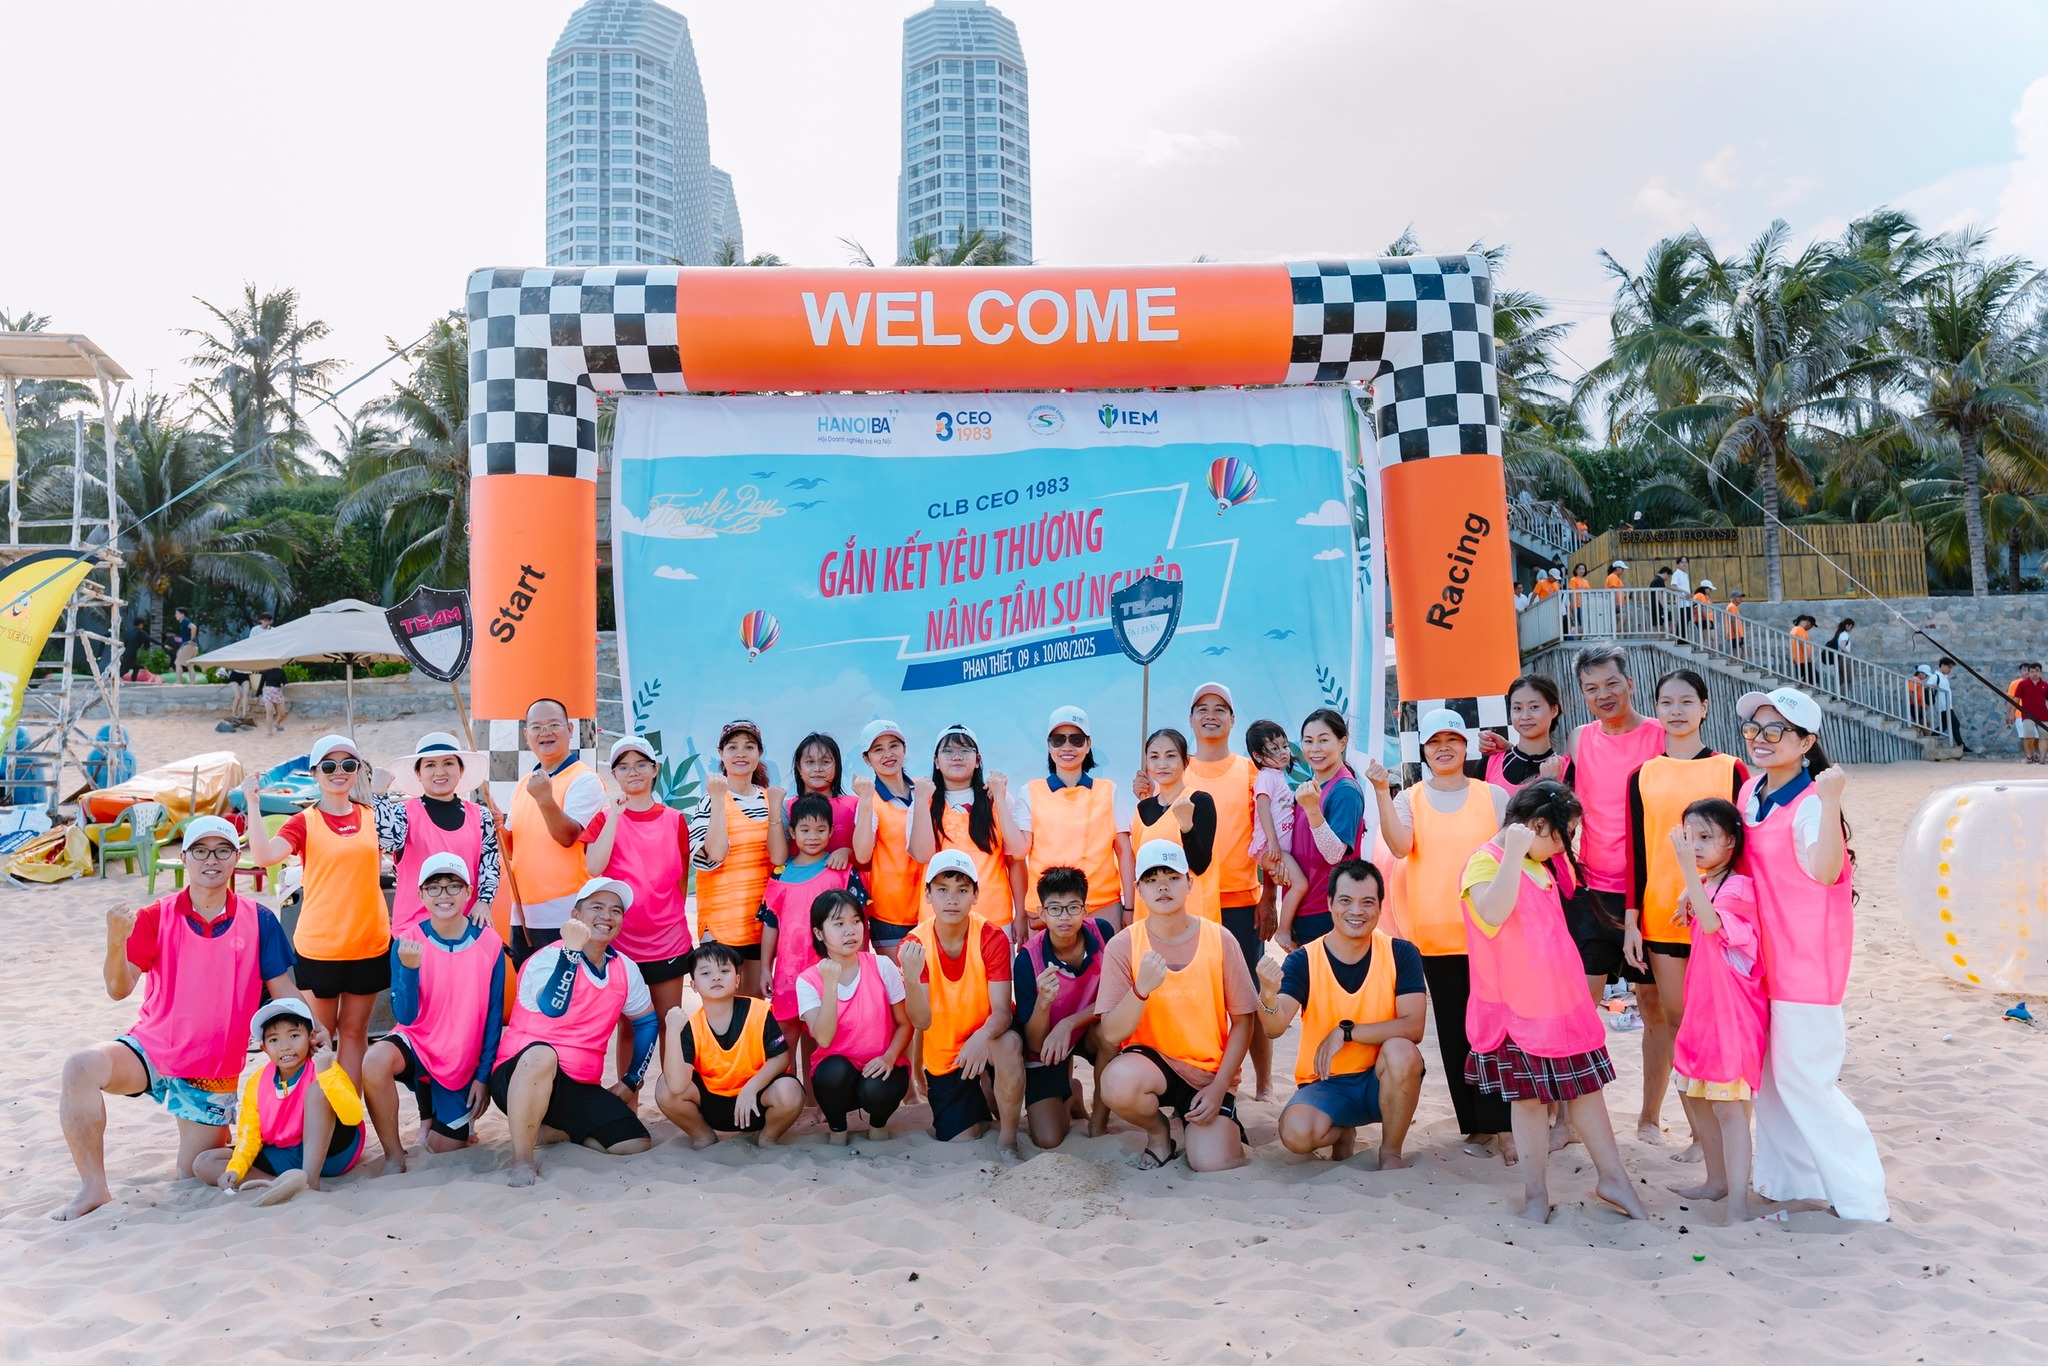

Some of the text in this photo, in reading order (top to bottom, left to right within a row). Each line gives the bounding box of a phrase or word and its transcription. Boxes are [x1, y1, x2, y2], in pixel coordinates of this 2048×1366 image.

[801, 286, 1180, 347] WELCOME
[817, 416, 891, 434] HANOIBA
[956, 411, 992, 425] CEO
[956, 427, 992, 442] 1983
[644, 484, 787, 538] Family Day
[928, 476, 1070, 520] CLB CEO 1983
[819, 508, 1104, 598] GẮN KẾT YÊU THƯƠNG
[1620, 528, 1739, 543] BEACH HOUSE
[1425, 512, 1490, 631] Racing
[400, 606, 462, 634] TEAM
[489, 564, 546, 644] Start
[926, 597, 994, 652] NÂNG
[999, 579, 1047, 638] TẦM
[1052, 572, 1086, 634] SỰ
[1120, 594, 1174, 617] TEAM
[8, 629, 33, 646] TEAM
[962, 637, 1096, 681] PHAN THIẾT, 09 & 10/08/2025
[1785, 698, 1798, 706] CEO
